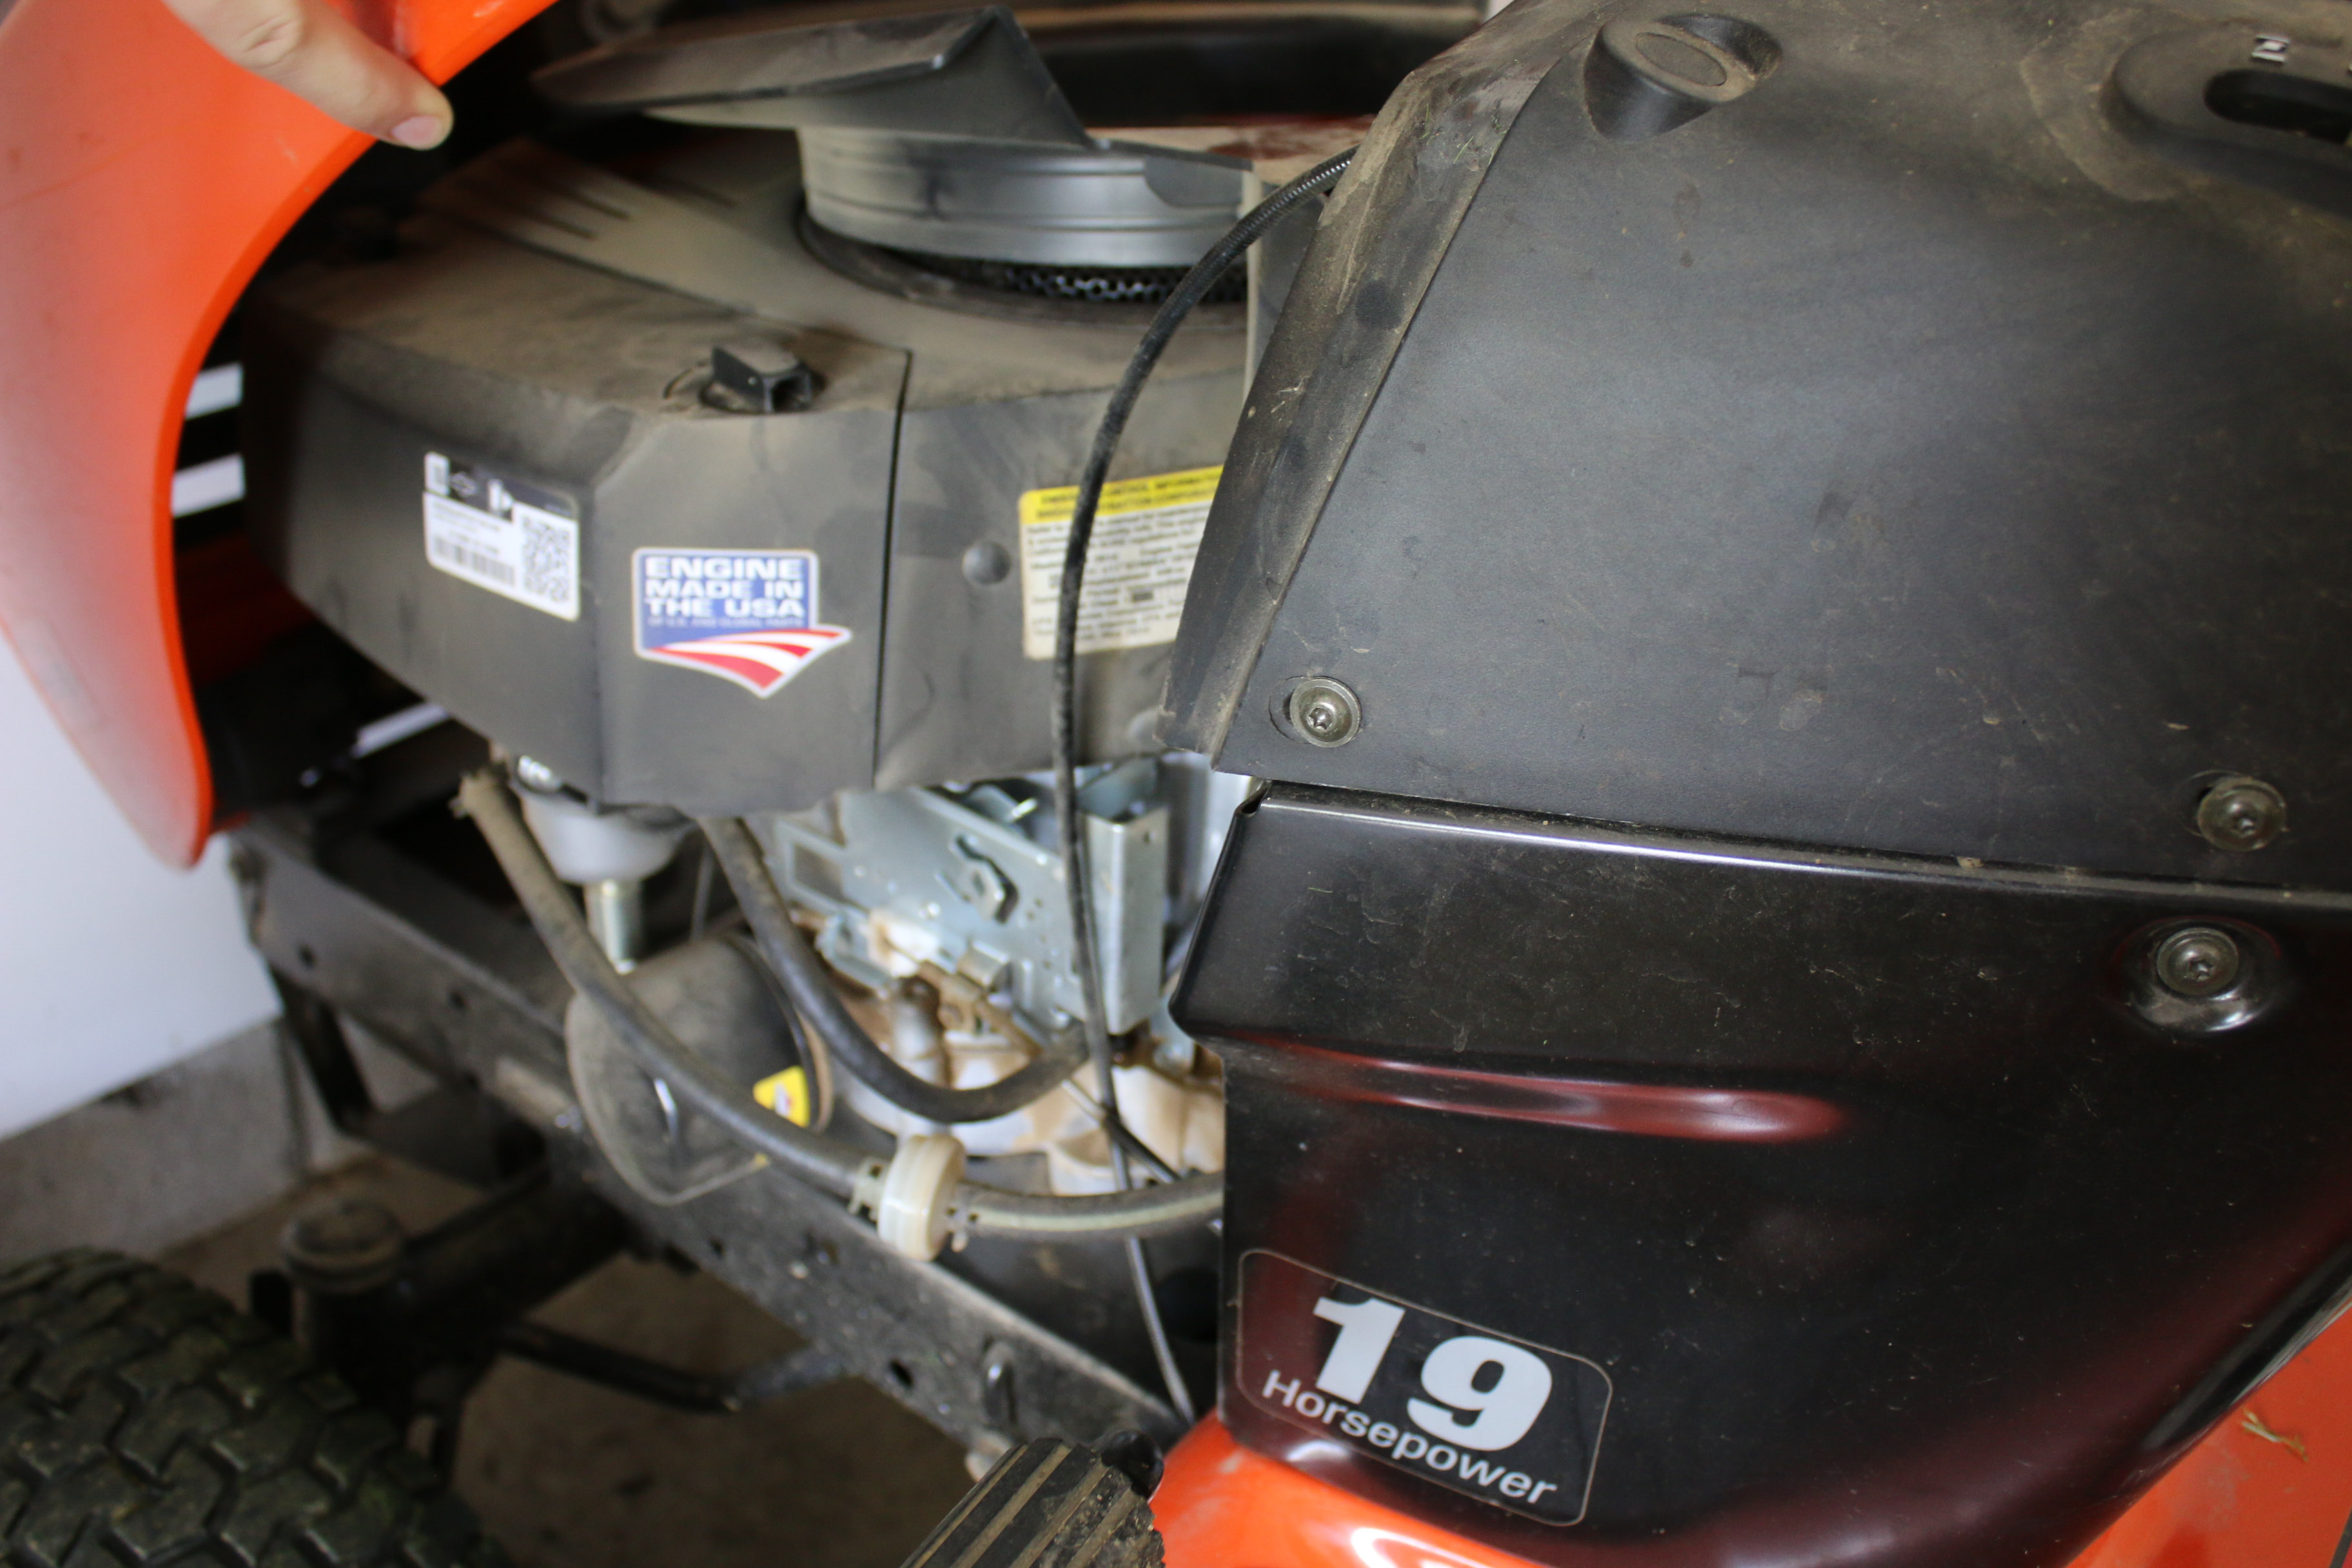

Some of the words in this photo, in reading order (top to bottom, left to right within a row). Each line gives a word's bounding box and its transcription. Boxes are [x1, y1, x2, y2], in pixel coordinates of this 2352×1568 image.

[645, 557, 803, 579] ENGINE
[645, 580, 752, 599] MADE
[764, 580, 804, 599] IN
[645, 598, 712, 617] THE
[723, 598, 805, 618] USA
[1313, 1297, 1553, 1451] 19
[1262, 1369, 1558, 1504] Horsepower
